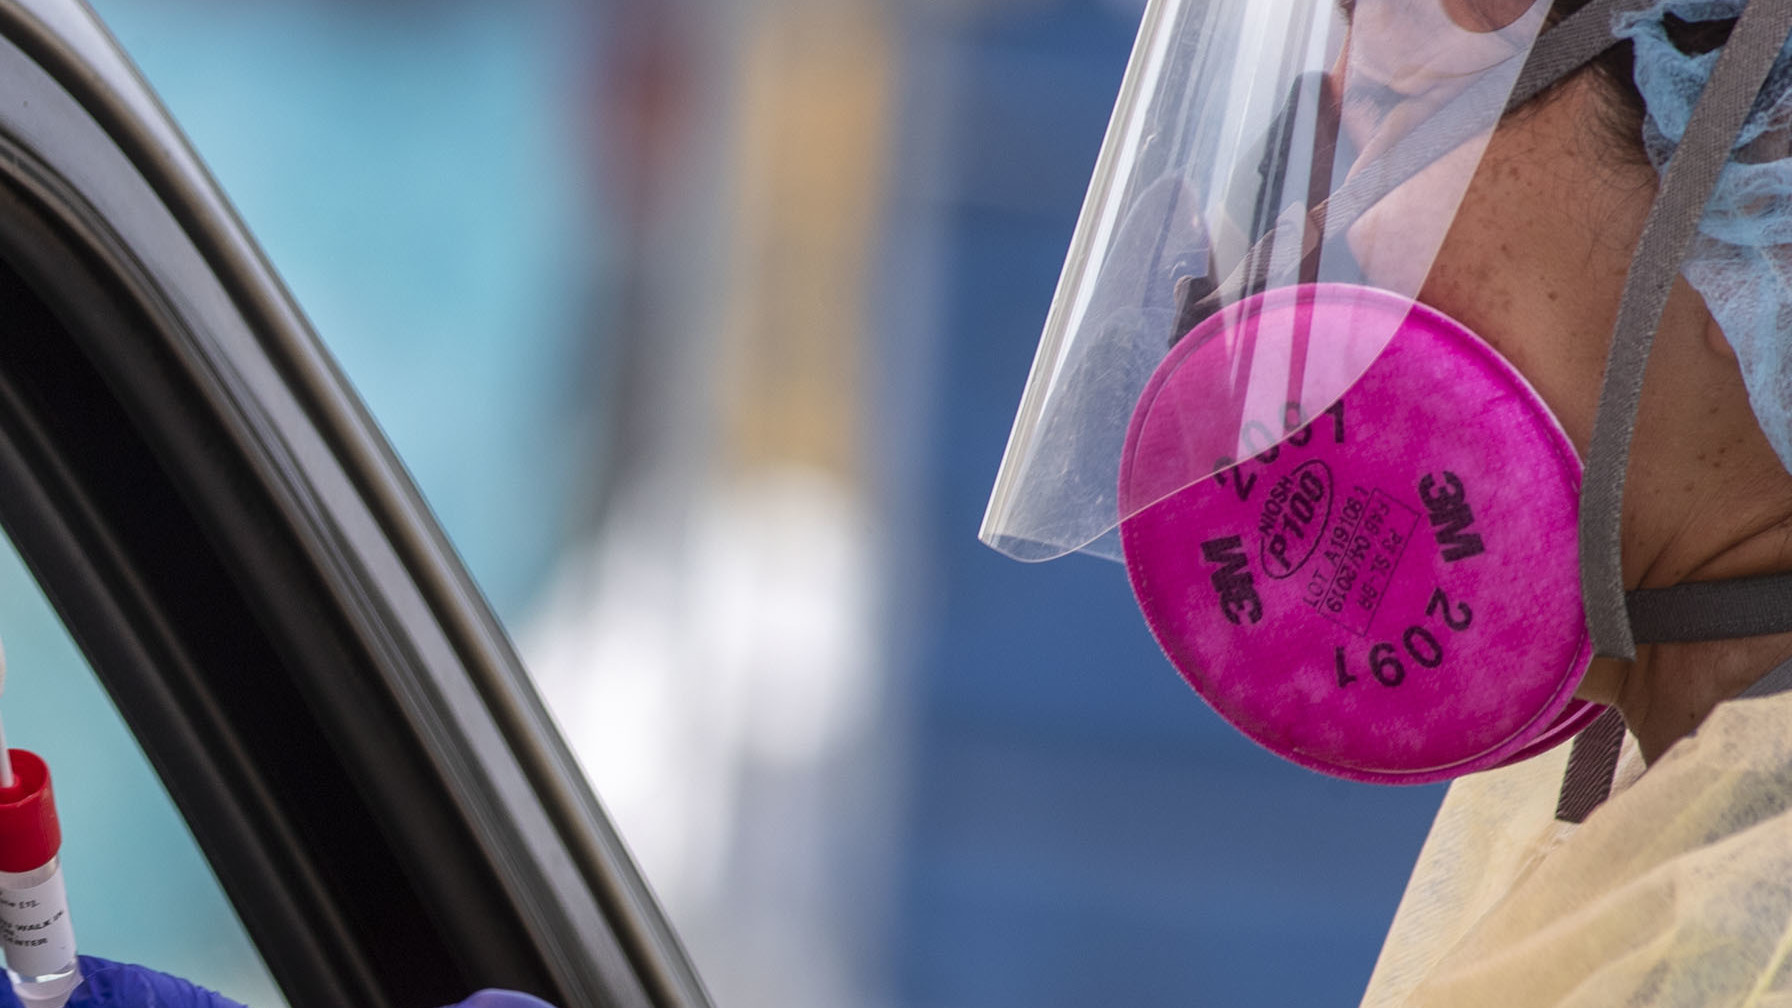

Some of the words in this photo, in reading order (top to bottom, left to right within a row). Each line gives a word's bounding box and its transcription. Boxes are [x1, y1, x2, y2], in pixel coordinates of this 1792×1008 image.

[1212, 400, 1346, 501] 2091
[1259, 475, 1295, 537] NIOSH
[1269, 470, 1325, 571] P100
[1418, 470, 1485, 563] 3M
[1200, 535, 1263, 626] 3M
[1303, 568, 1328, 607] LOT
[1335, 587, 1473, 689] 2091
